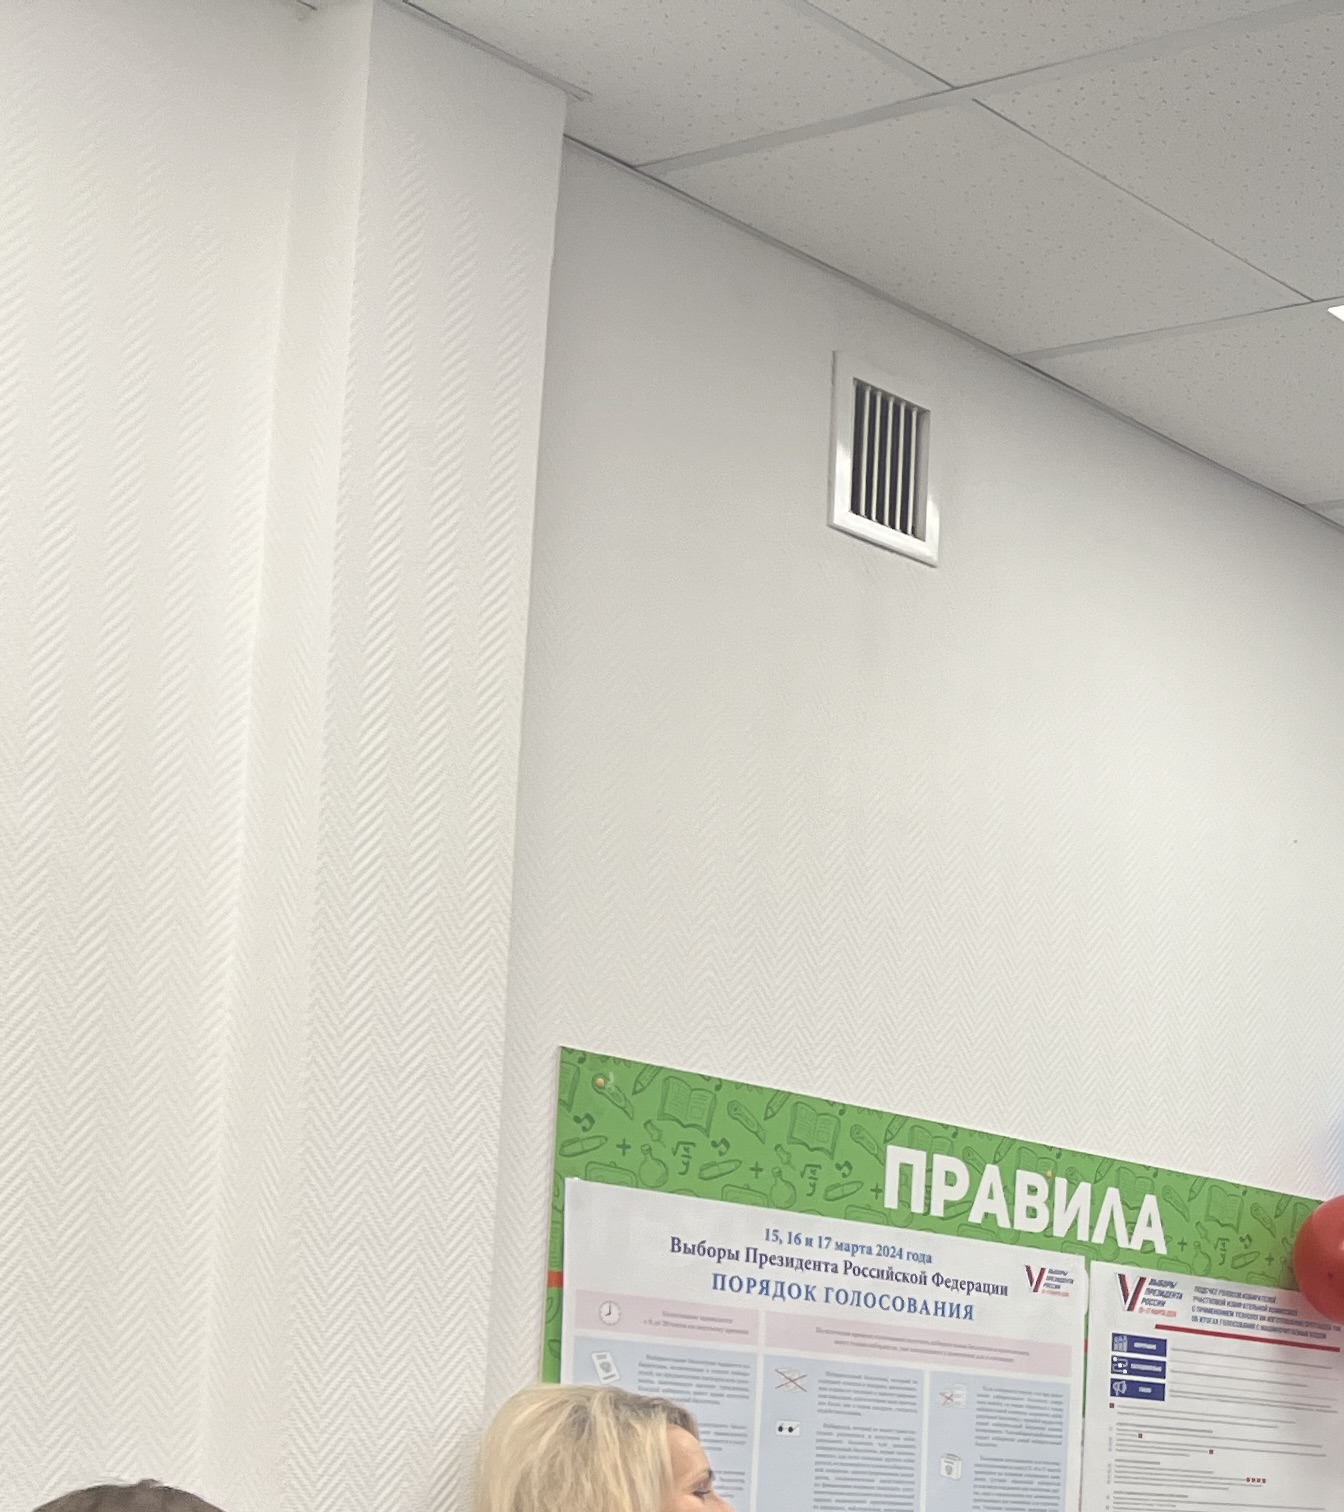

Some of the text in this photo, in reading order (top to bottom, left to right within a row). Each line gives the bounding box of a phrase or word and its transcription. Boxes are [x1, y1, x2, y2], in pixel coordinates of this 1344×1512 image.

[884, 1144, 1167, 1254] ПРАВИЛА
[670, 1236, 1009, 1298] Выборы Президента Российской Федерации
[765, 1227, 933, 1264] 15, 16 и 17 марта 2024 года
[711, 1272, 976, 1322] ПОРЯДОК ГОЛОСОВАНИЯ
